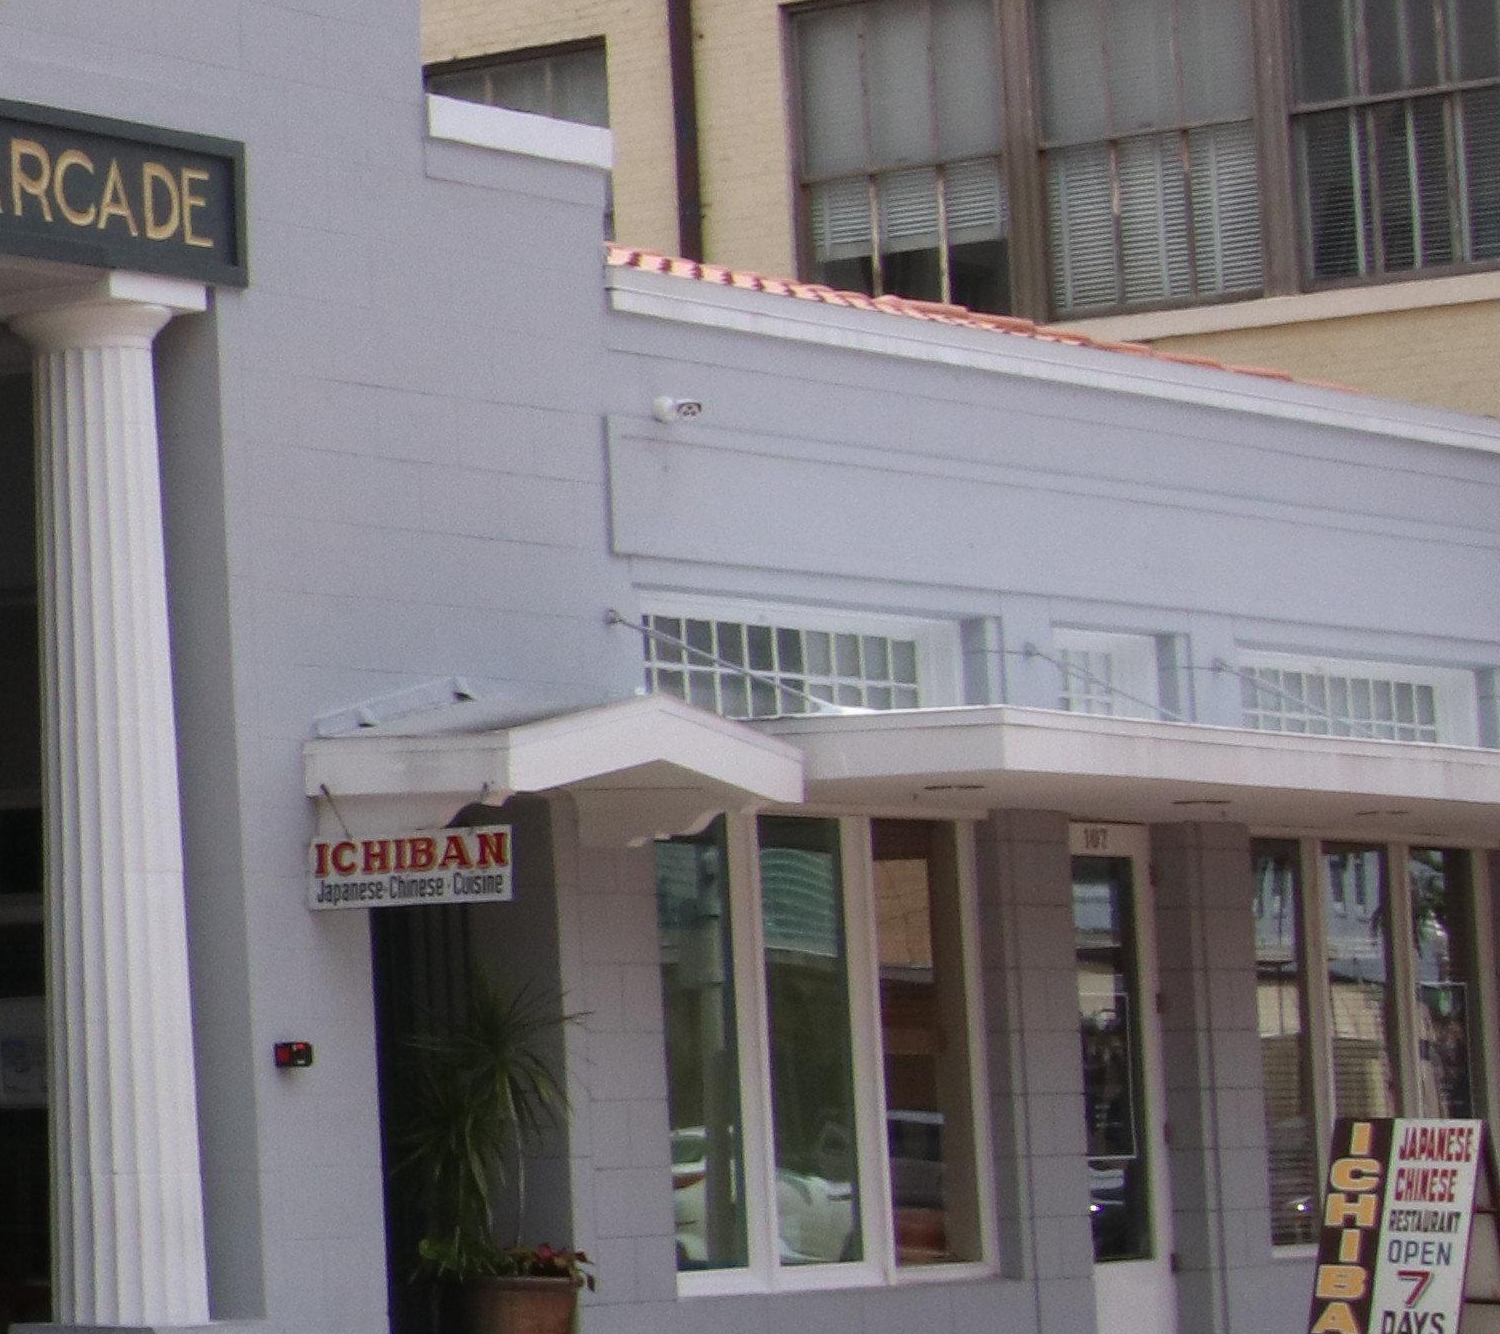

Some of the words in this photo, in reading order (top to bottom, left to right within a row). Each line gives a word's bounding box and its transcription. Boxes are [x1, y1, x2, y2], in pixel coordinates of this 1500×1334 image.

[314, 832, 509, 879] ICHIBAN
[453, 872, 504, 895] Cuisine
[1399, 1127, 1474, 1163] JAPANESE
[1394, 1168, 1459, 1203] CHINESE
[1388, 1209, 1462, 1233] RESTAURANT
[1387, 1239, 1453, 1266] OPEN
[1396, 1269, 1434, 1309] 7
